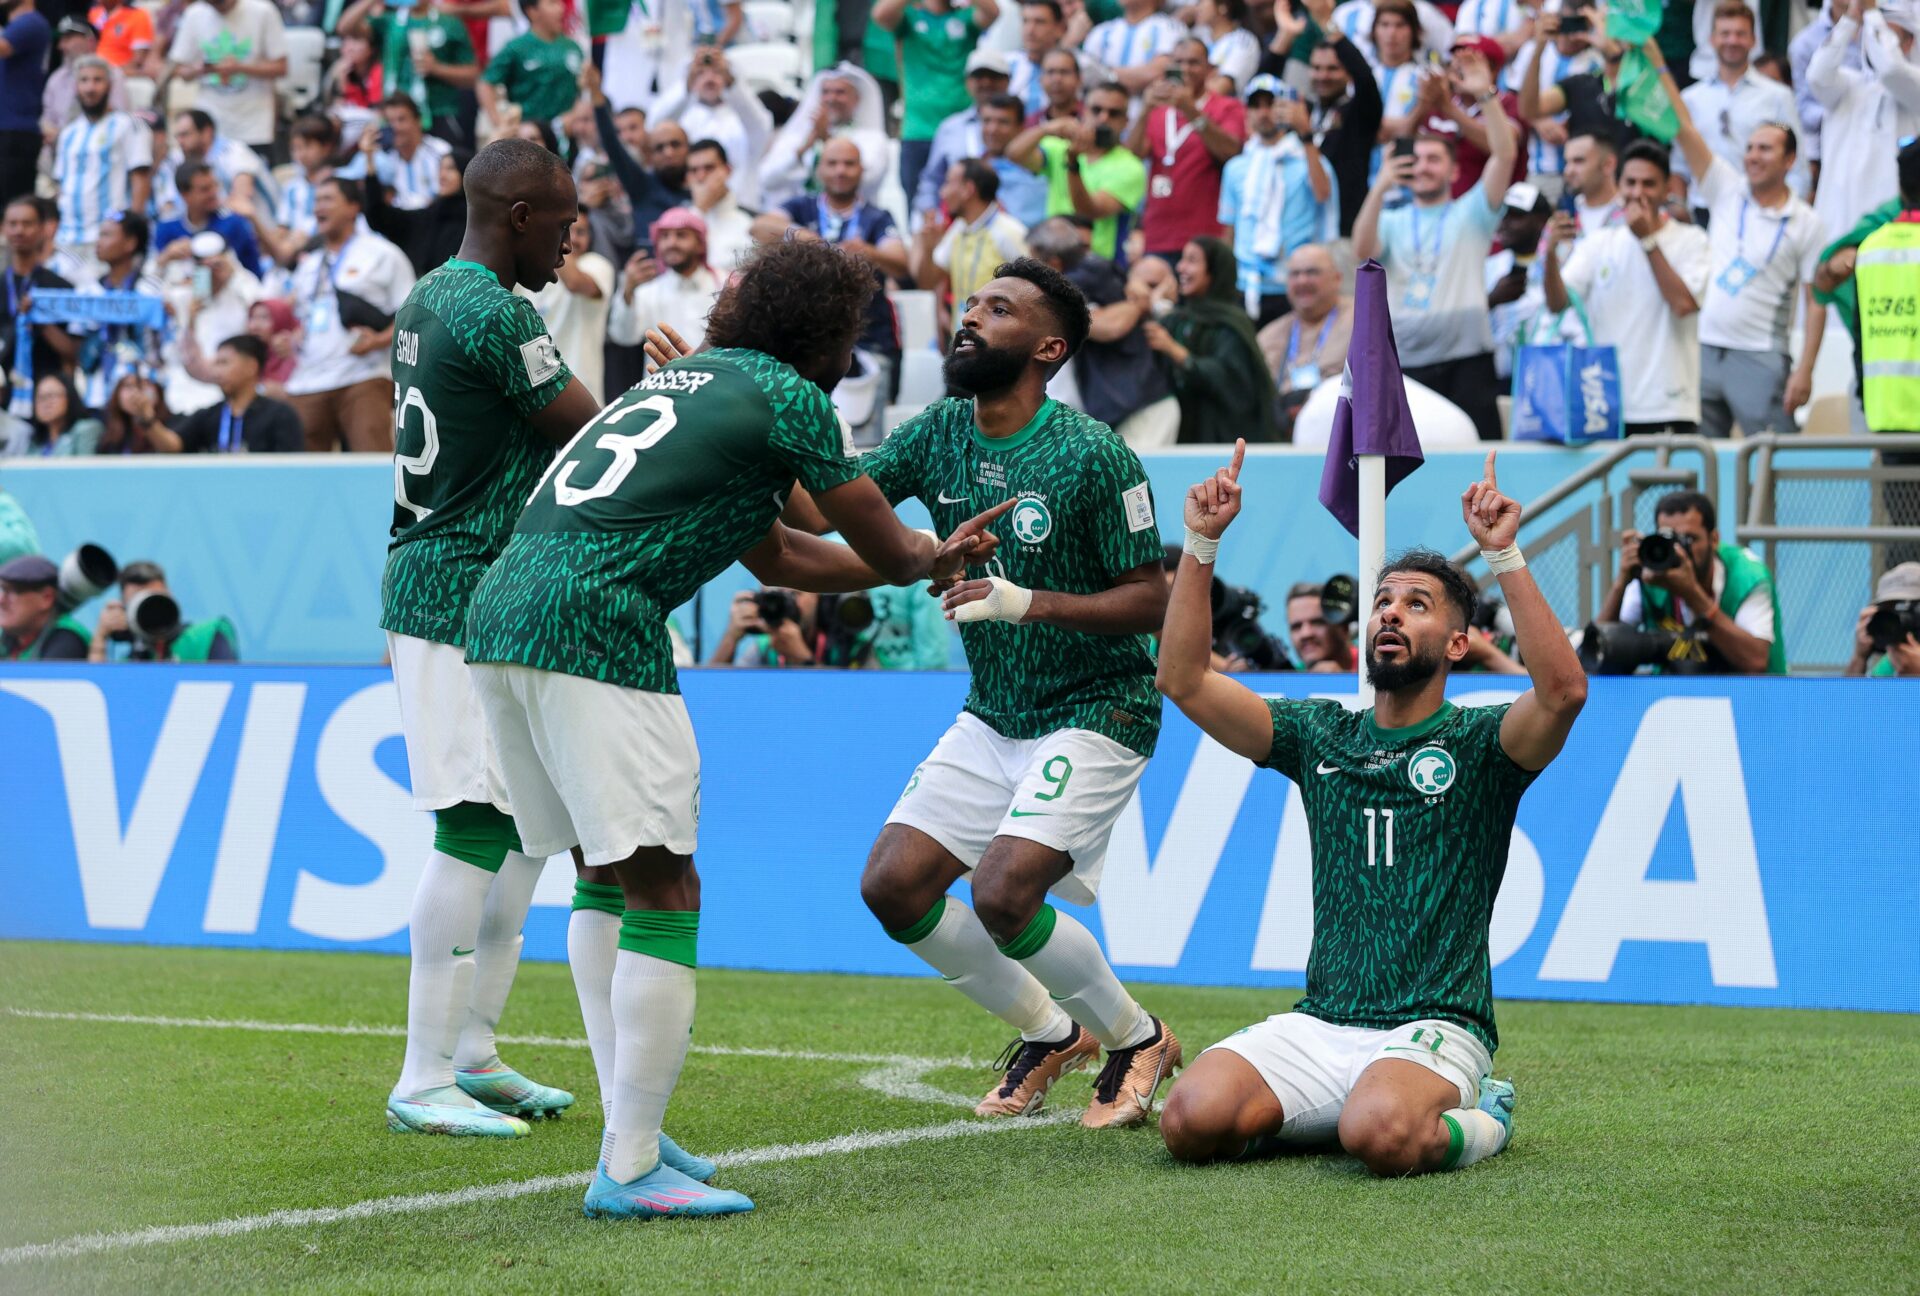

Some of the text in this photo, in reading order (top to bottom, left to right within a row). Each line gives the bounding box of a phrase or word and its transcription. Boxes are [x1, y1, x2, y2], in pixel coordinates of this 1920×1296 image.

[397, 329, 419, 367] SAUD
[1034, 755, 1073, 801] 9
[1424, 796, 1445, 804] KSA
[0, 678, 577, 942] VIS
[1363, 808, 1393, 867] 11
